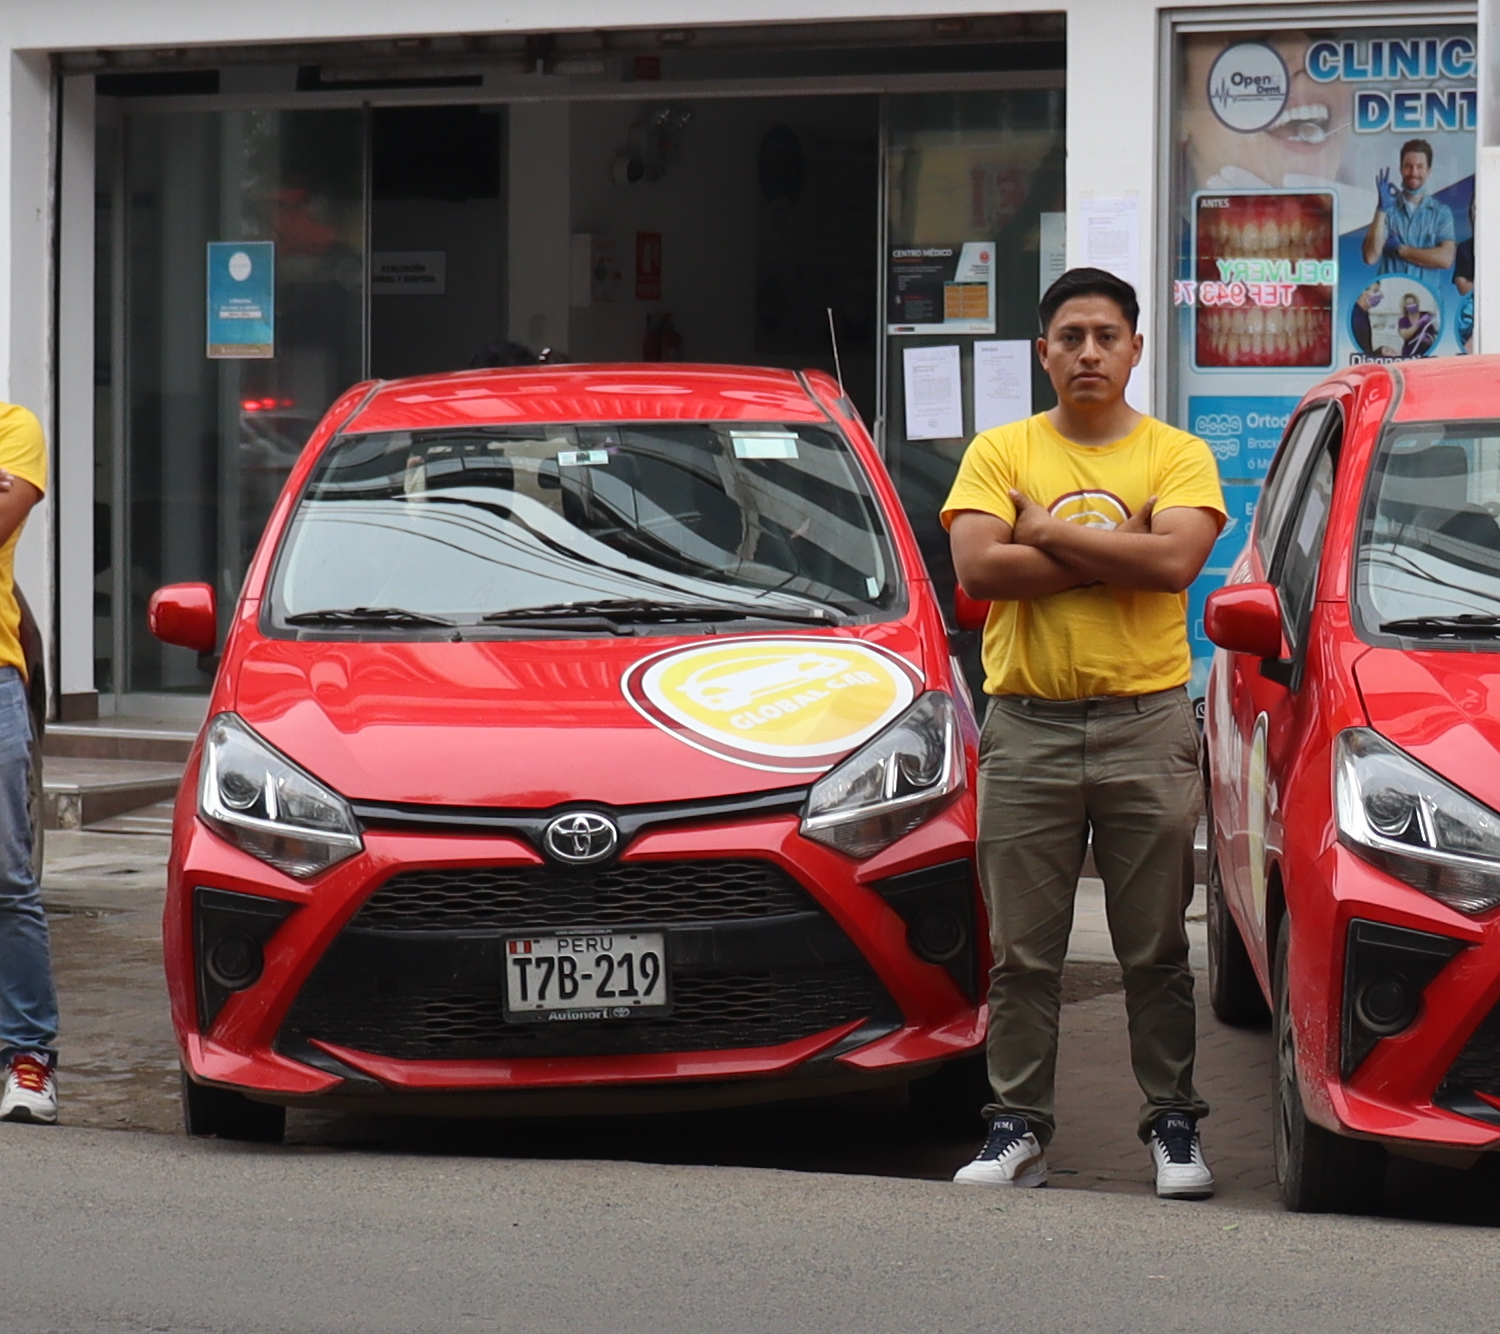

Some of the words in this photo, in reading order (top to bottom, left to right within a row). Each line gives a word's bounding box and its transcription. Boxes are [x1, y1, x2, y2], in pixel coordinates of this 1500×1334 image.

[1307, 38, 1477, 82] CLINIC
[1230, 71, 1272, 90] Open
[1256, 84, 1281, 95] Dent
[1201, 198, 1230, 208] ANTES
[728, 689, 832, 731] GLOBAL
[824, 670, 881, 689] CAR
[557, 937, 614, 953] PERU
[512, 951, 660, 1001] T7B-219
